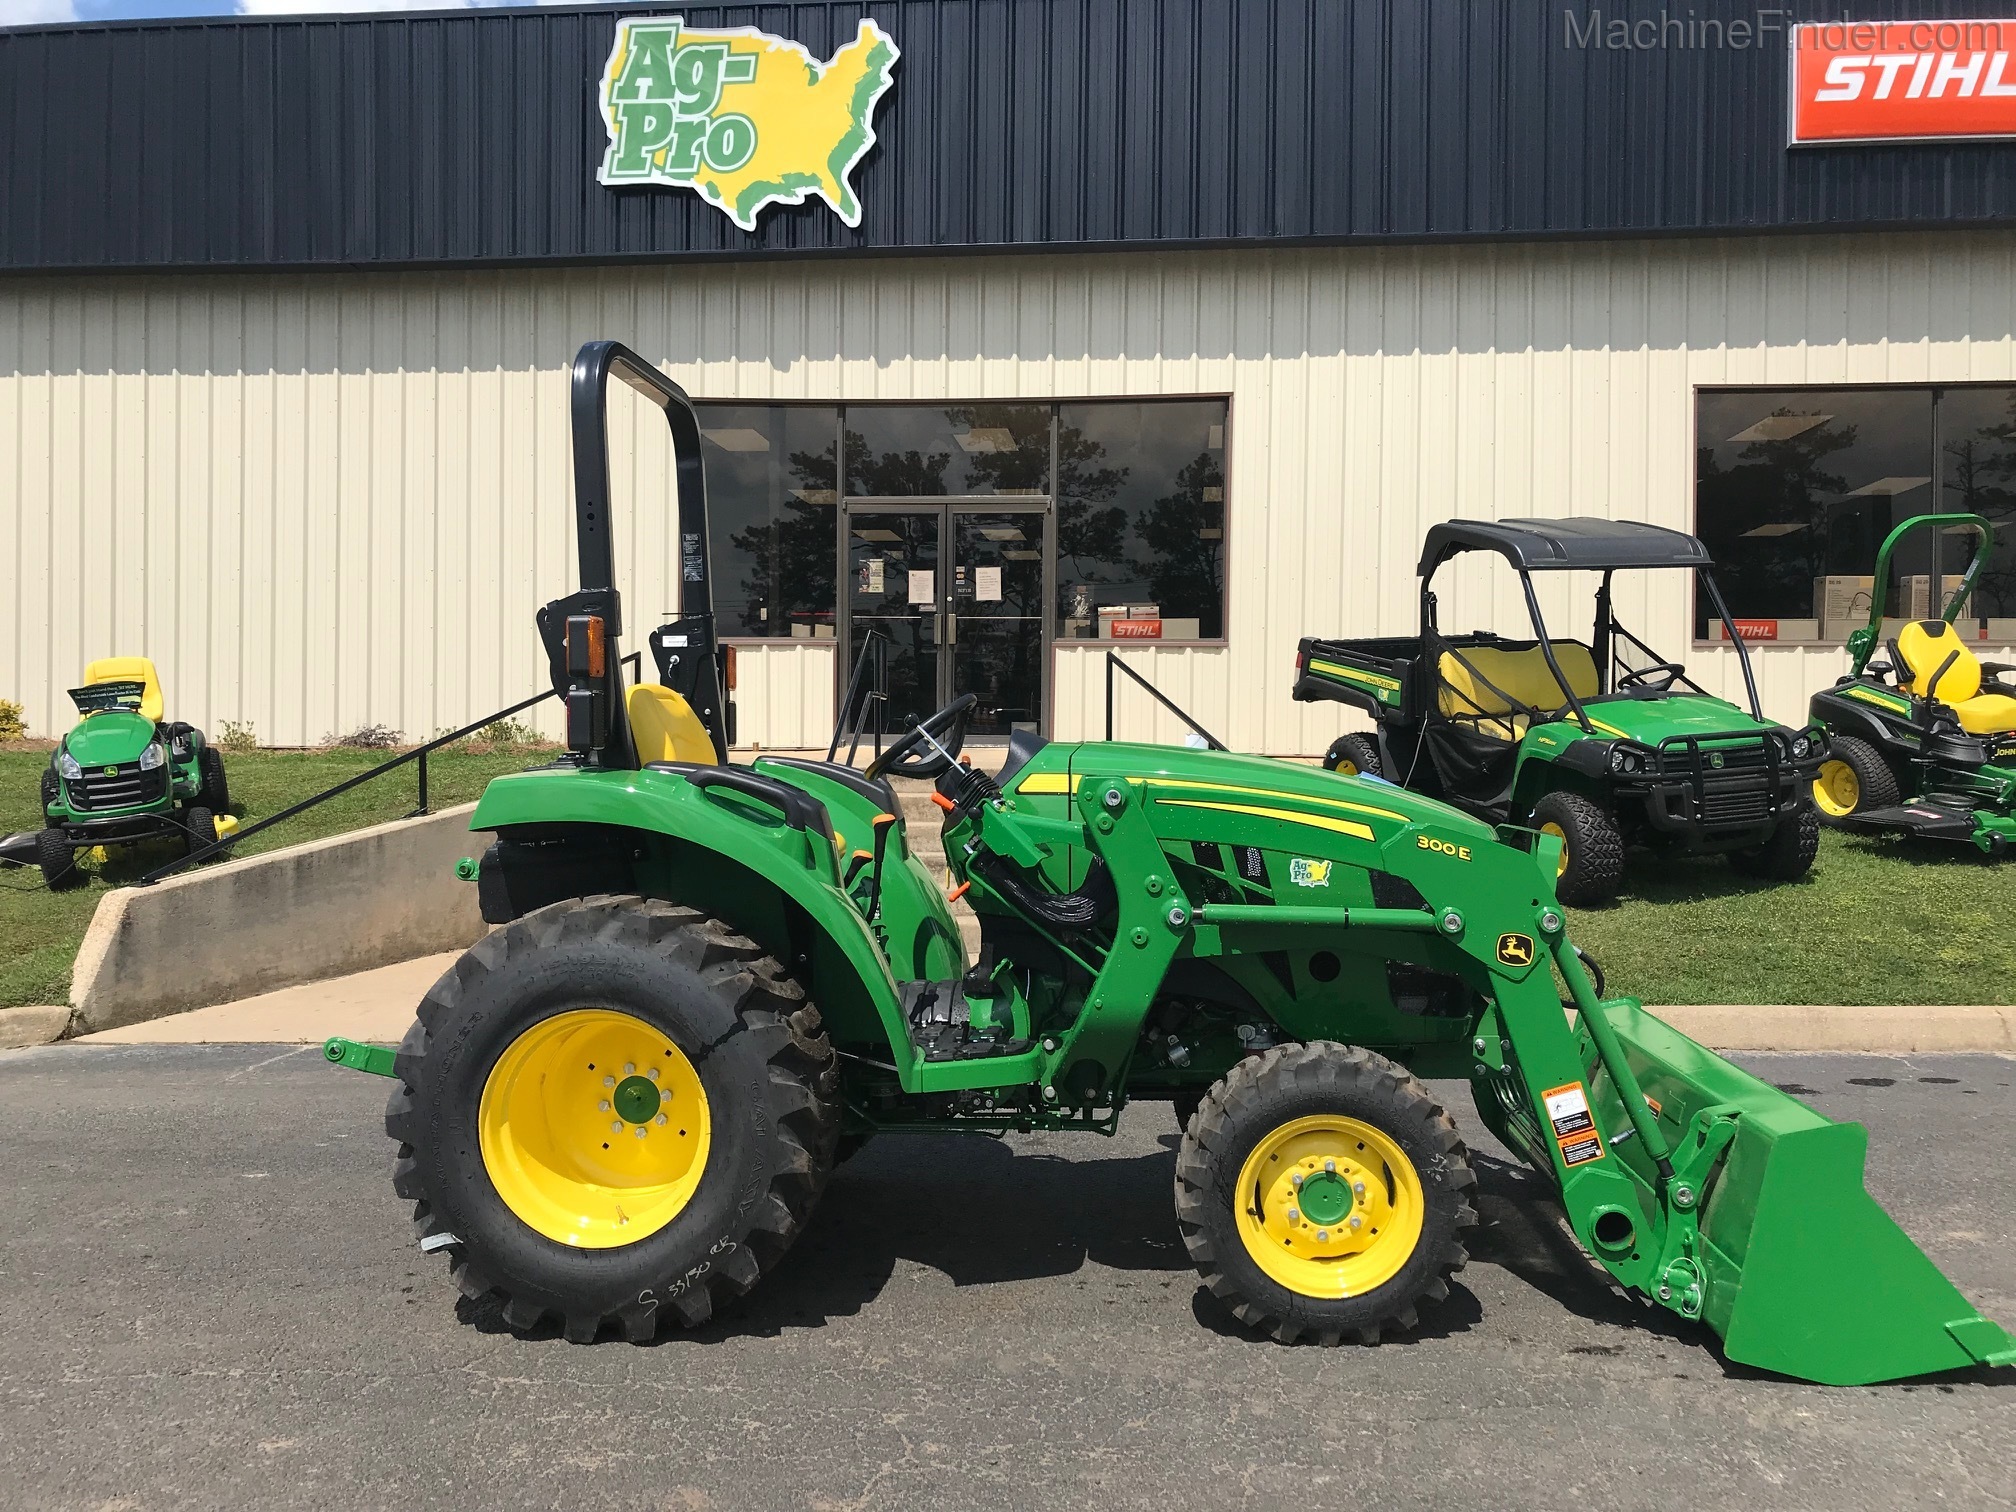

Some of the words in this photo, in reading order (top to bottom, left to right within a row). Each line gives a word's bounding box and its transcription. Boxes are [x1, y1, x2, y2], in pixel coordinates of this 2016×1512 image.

[610, 24, 758, 118] Ag-
[1814, 52, 2016, 101] STIHL
[608, 103, 757, 177] Pro
[1115, 625, 1156, 636] STIHL
[1735, 625, 1773, 637] TIHL
[1995, 748, 2016, 756] JOHN
[1294, 871, 1311, 880] Pro
